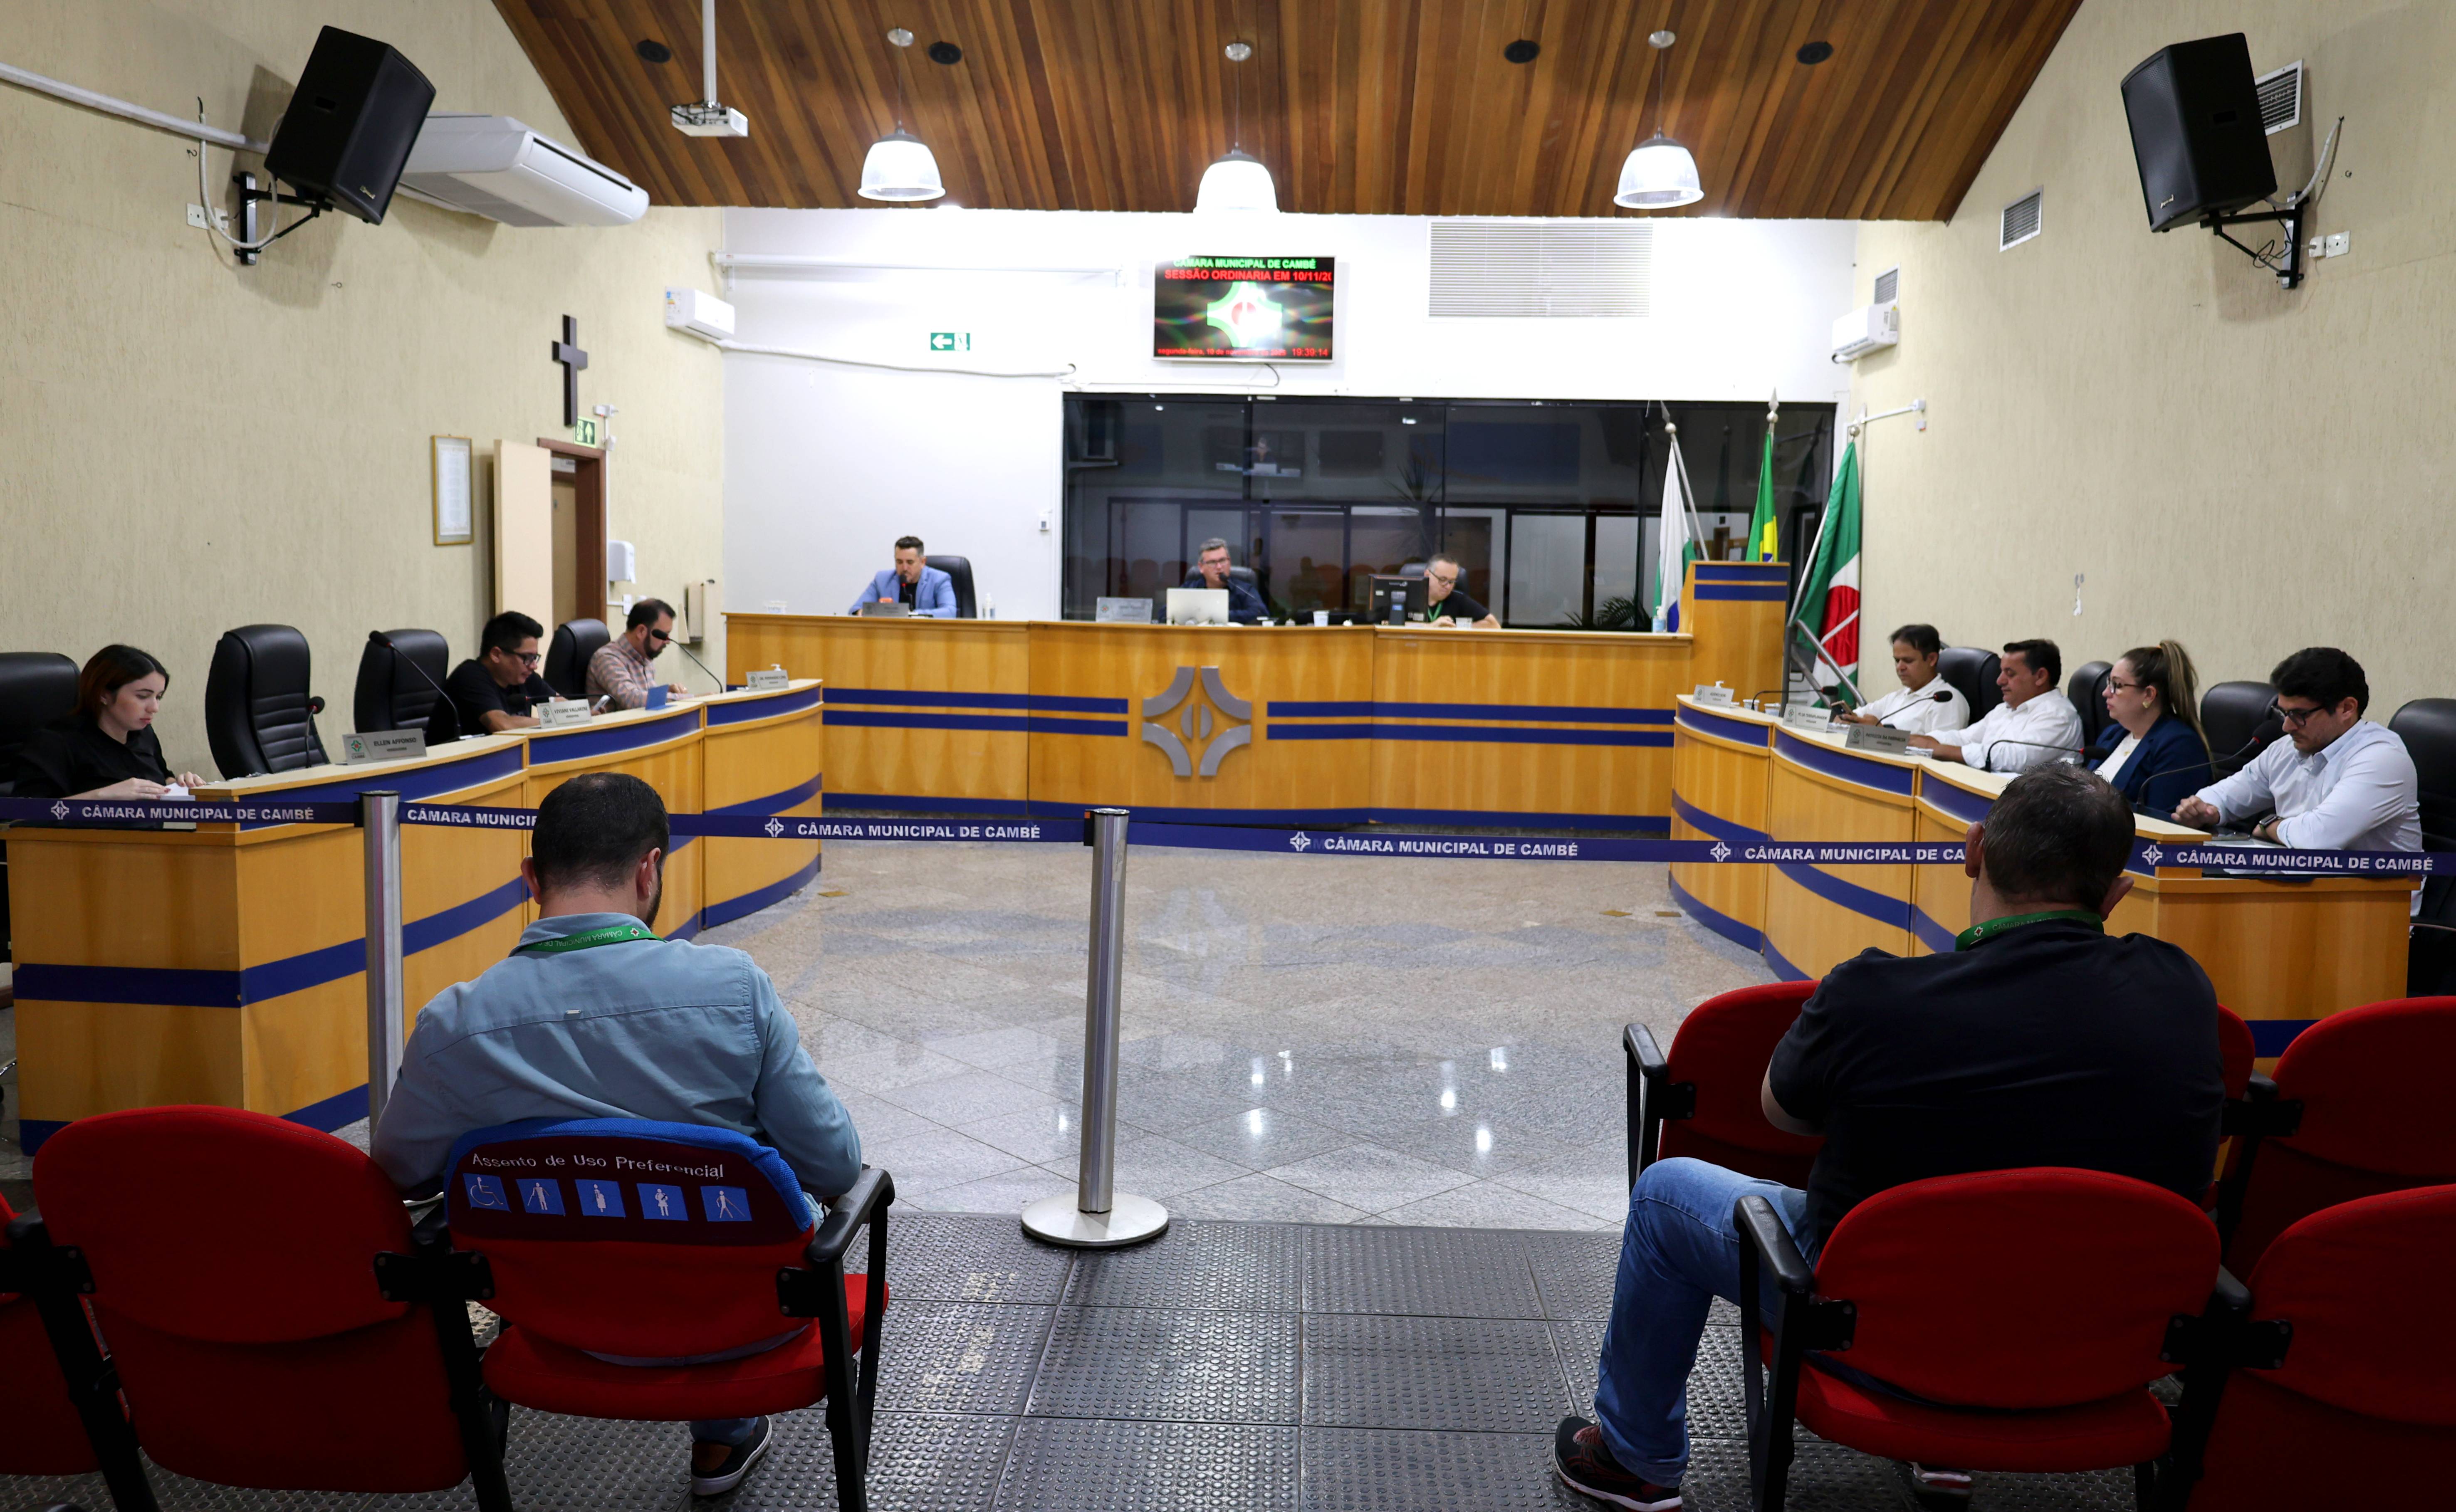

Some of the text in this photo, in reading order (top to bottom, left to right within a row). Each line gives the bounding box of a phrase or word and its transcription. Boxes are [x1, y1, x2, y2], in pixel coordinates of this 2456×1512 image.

[1215, 259, 1266, 268] MUNICIPAL
[1267, 260, 1281, 269] DE
[1282, 258, 1316, 269] CAMBÉ
[1165, 267, 1209, 280] SESSÃO
[1211, 270, 1271, 281] ORDINARIA
[1274, 271, 1290, 281] EM
[1292, 348, 1328, 357] 19:39:14
[82, 805, 314, 820] CÂMARA MUNICIPAL DE CAMBÉ
[408, 808, 537, 826] CÂMARA MUNICIP
[798, 823, 1040, 838] CÂMARA MUNICIPAL DE CAMBÉ
[1324, 837, 1578, 856] CÂMARA MUNICIPAL DE CAMBÉ
[1745, 846, 1965, 860] CÂMARA MUNICIPAL DE CA
[2177, 850, 2433, 870] CÂMARA MUNICIPAL DE CAMBÉ
[554, 936, 591, 946] MUNICIPAL
[592, 930, 623, 940] CÂMARA
[473, 1153, 723, 1178] Assento de Uso Preferencial
